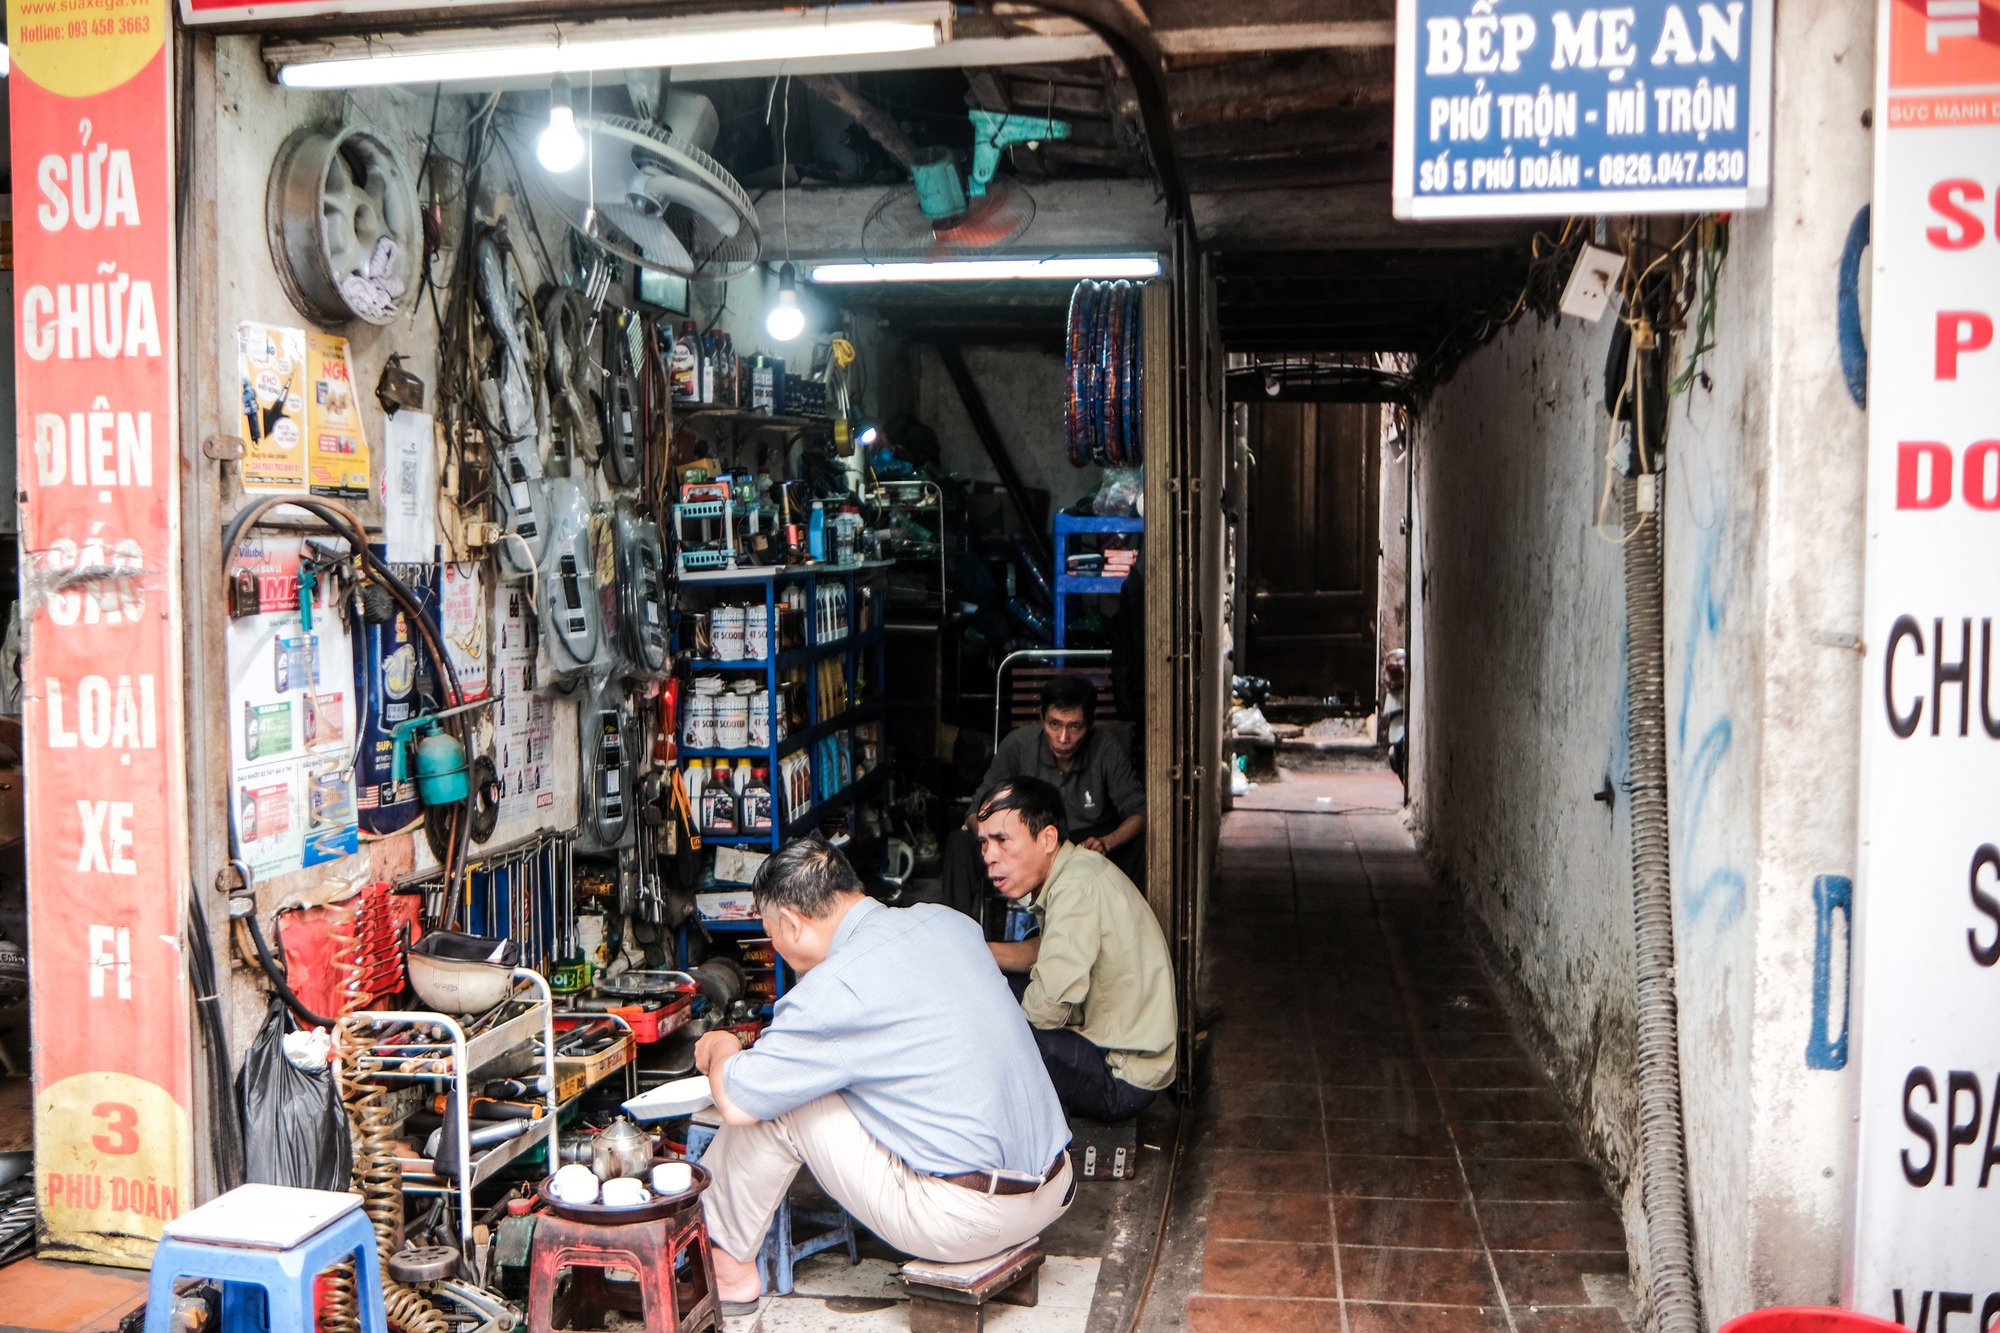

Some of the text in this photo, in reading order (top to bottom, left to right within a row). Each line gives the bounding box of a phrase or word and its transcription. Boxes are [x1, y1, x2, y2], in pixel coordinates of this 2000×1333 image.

[20, 16, 151, 43] Hotline: 093 458 3663
[1426, 0, 1744, 82] BẾP MẸ AN
[1430, 78, 1493, 142] PHỞ
[1498, 84, 1578, 147] TRỘN
[1606, 79, 1646, 136] MÌ
[1654, 77, 1737, 142] TRỘN
[1890, 102, 1930, 122] SỨC
[1934, 101, 1987, 124] MẠNH
[37, 117, 142, 233] SỬA
[1420, 149, 1450, 191] SỐ
[1453, 159, 1467, 188] 5
[1472, 145, 1516, 190] PHỦ
[1520, 153, 1580, 189] DOÃN
[1599, 150, 1745, 186] 0826.047.830
[1926, 177, 2000, 252] S
[22, 260, 163, 362] CHỮA
[34, 394, 154, 505] ĐIỆN
[240, 547, 264, 558] Vilube
[47, 674, 157, 766] LOẠI
[76, 800, 137, 874] XE
[756, 821, 770, 829] MOTU
[88, 924, 132, 999] FI
[91, 1102, 140, 1155] 3
[47, 1160, 178, 1221] PHỦ DOÃN
